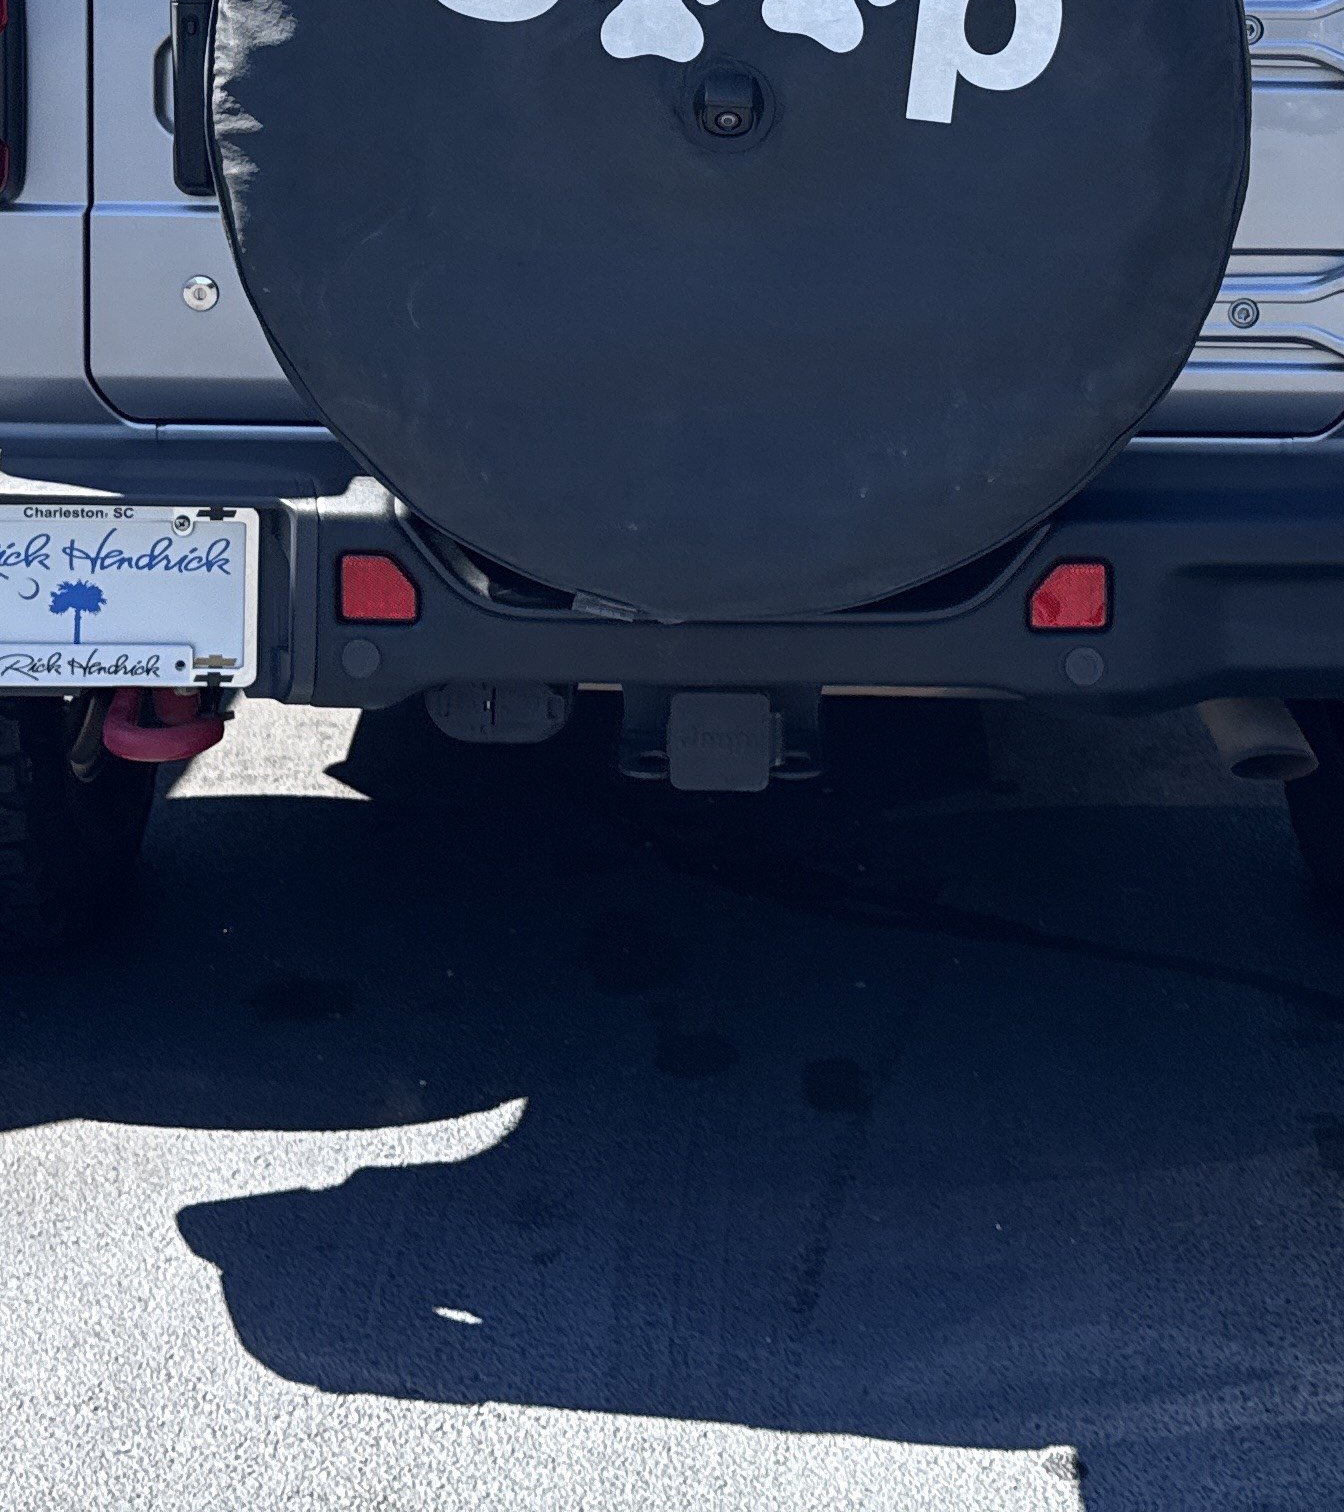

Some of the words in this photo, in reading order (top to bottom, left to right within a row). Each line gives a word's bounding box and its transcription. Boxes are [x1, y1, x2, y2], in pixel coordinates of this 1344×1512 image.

[113, 507, 135, 519] SC
[62, 528, 231, 576] Hendrick
[67, 649, 161, 678] Hendrick
